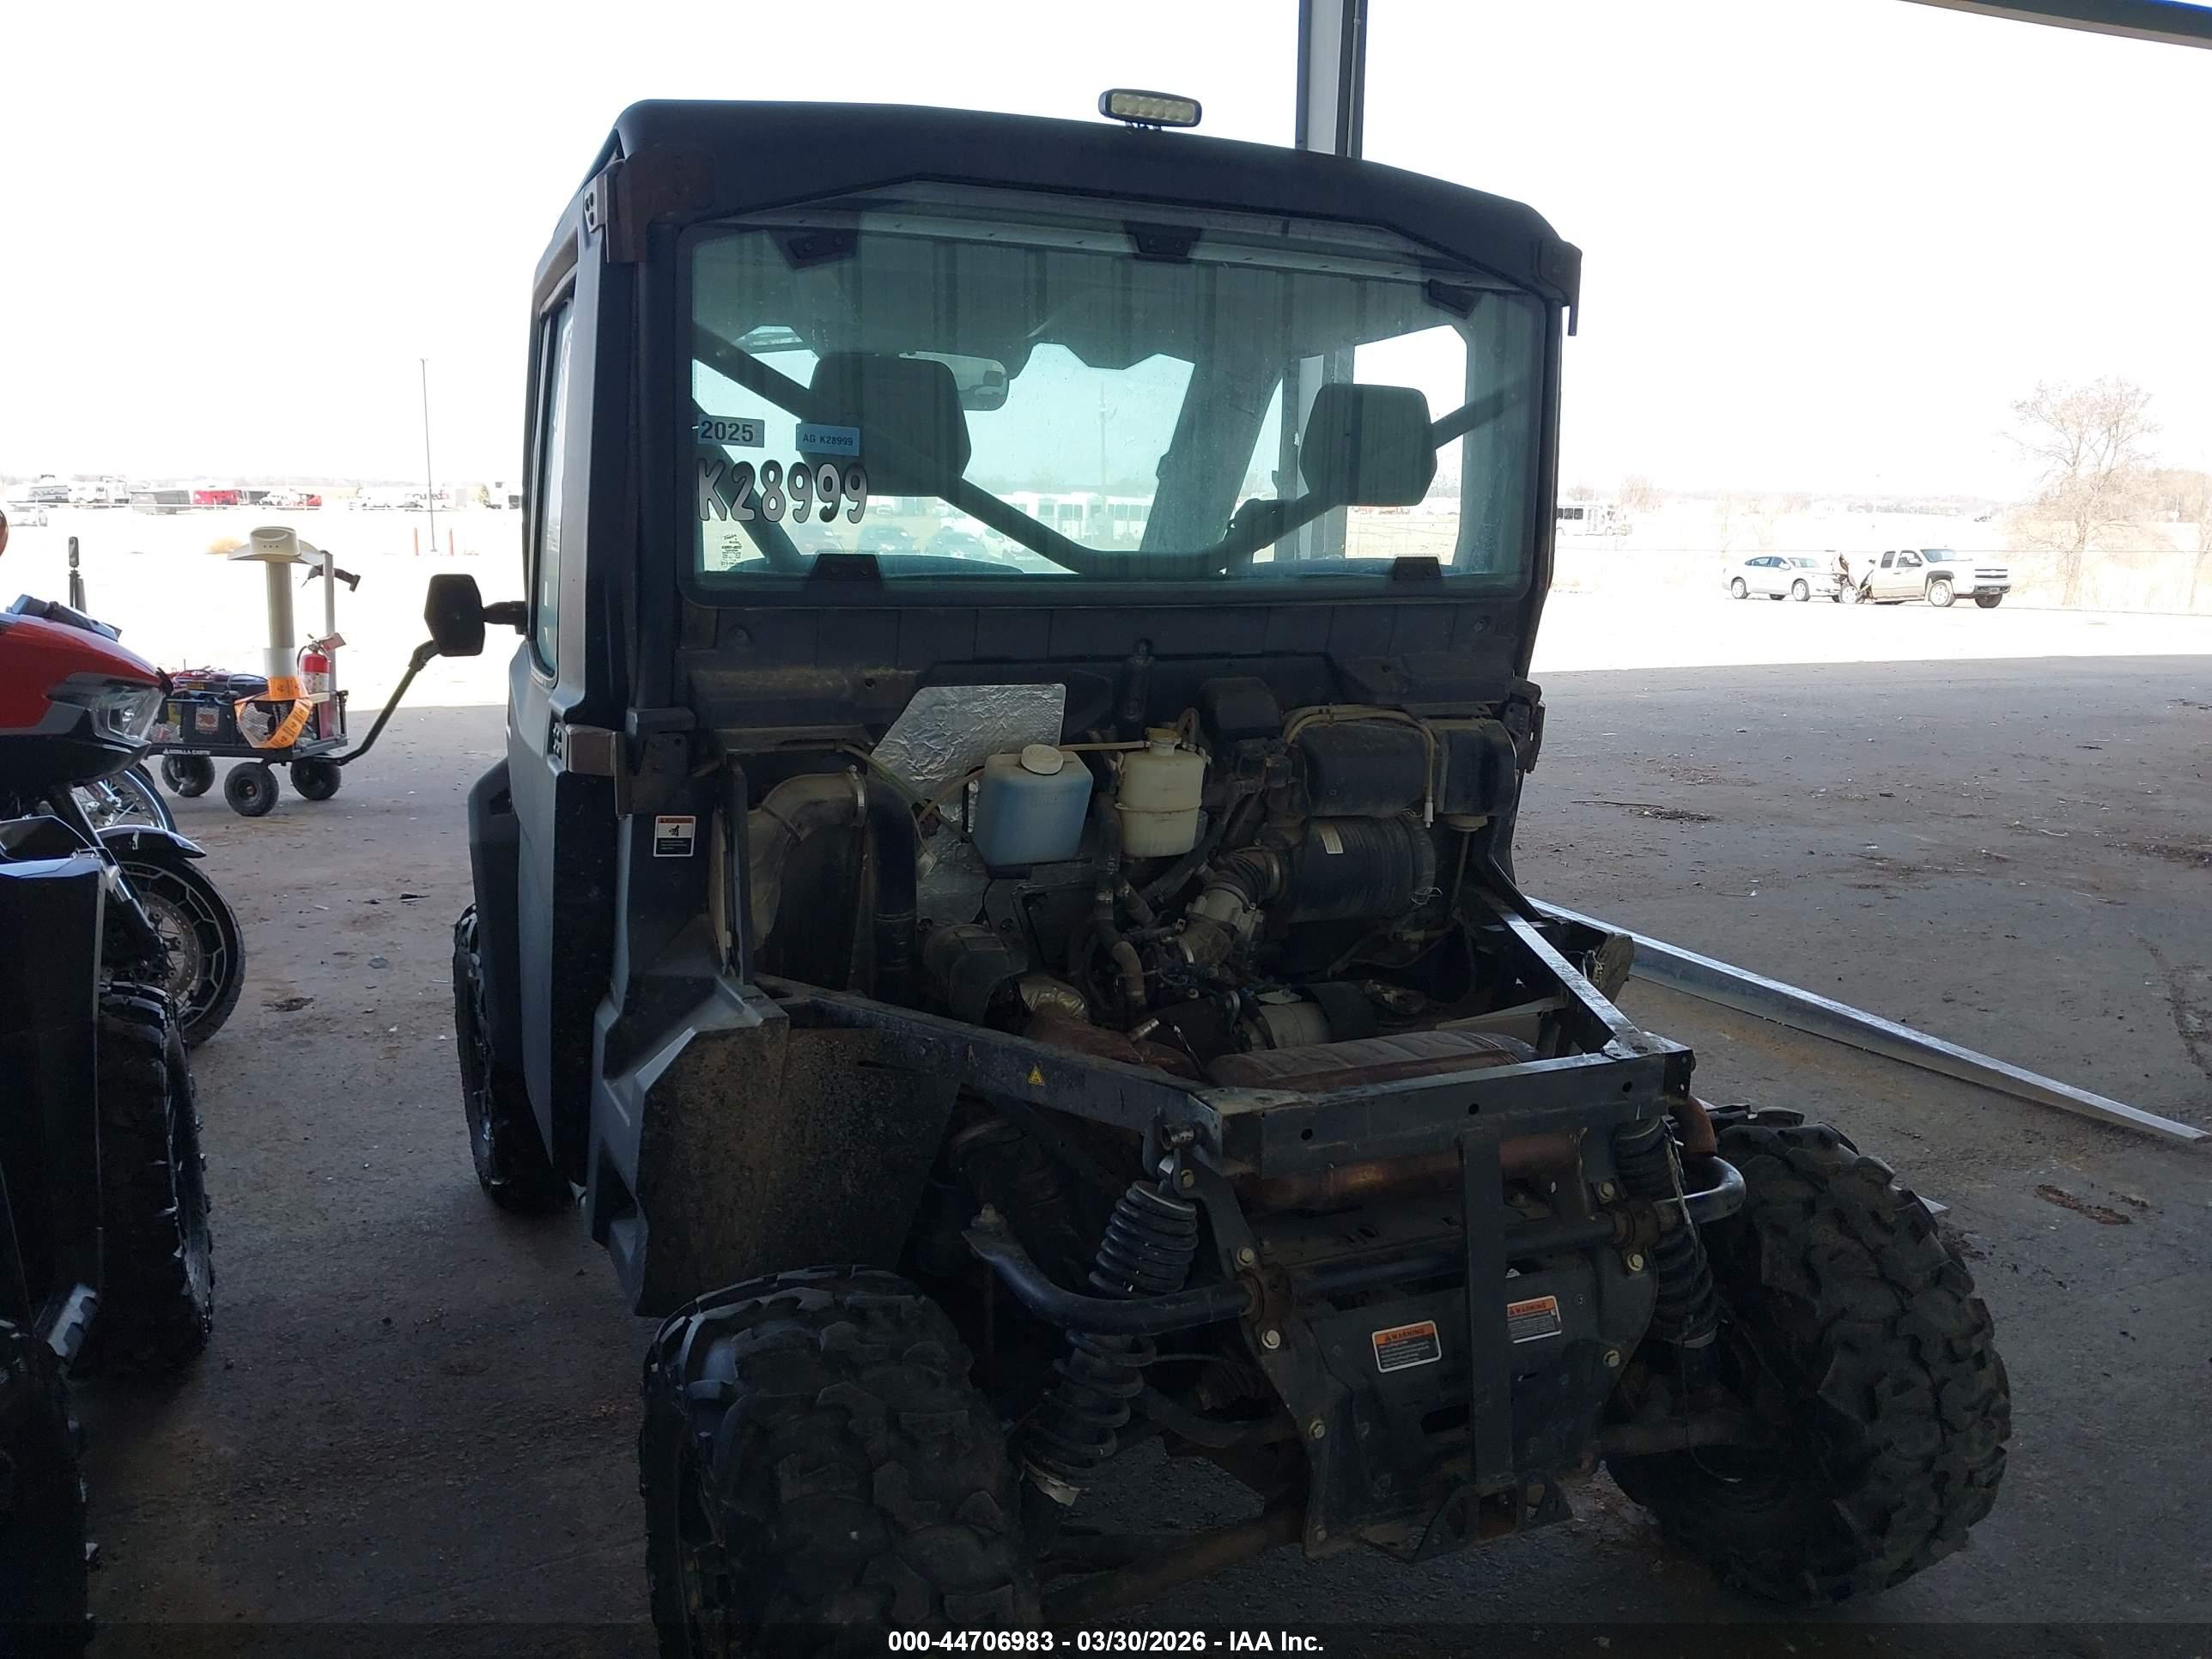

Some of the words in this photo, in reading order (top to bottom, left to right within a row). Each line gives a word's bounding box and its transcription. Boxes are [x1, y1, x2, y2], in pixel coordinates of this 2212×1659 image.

[701, 420, 754, 442] 2025
[803, 433, 816, 443] AG
[819, 434, 853, 446] K28999
[697, 458, 869, 524] K28999
[1516, 1302, 1547, 1314] WARNING
[1391, 1328, 1425, 1340] WARNING
